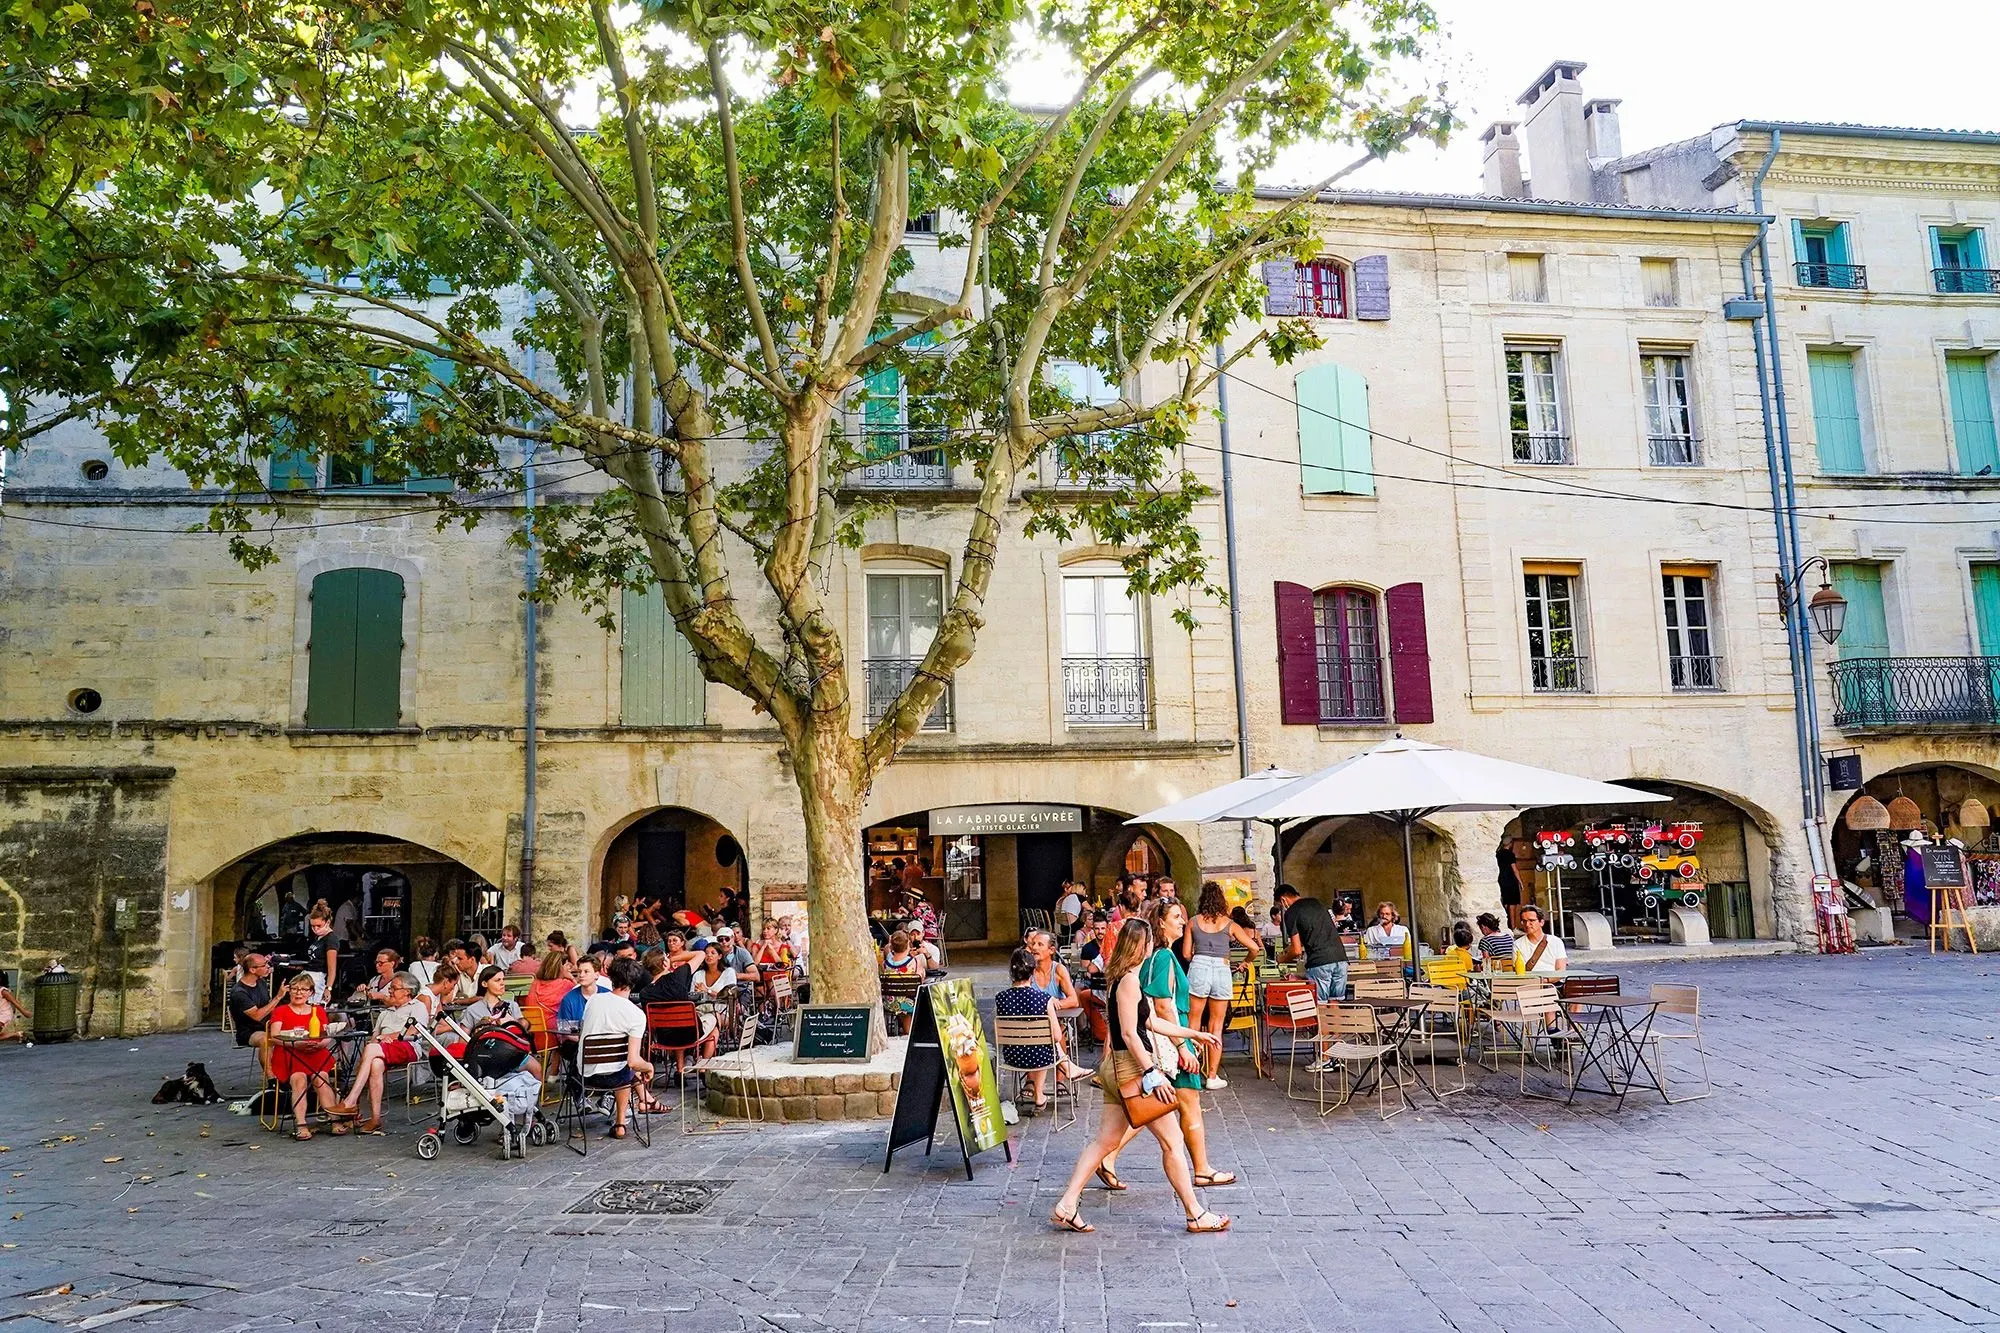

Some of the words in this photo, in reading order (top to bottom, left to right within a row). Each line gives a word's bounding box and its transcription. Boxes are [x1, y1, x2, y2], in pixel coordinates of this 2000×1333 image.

[936, 816, 953, 825] LA
[958, 813, 1026, 824] FABRIQUE
[1031, 811, 1074, 822] GIVRÉE
[970, 824, 1003, 832] ARTISTE
[1006, 823, 1040, 831] GLACIER
